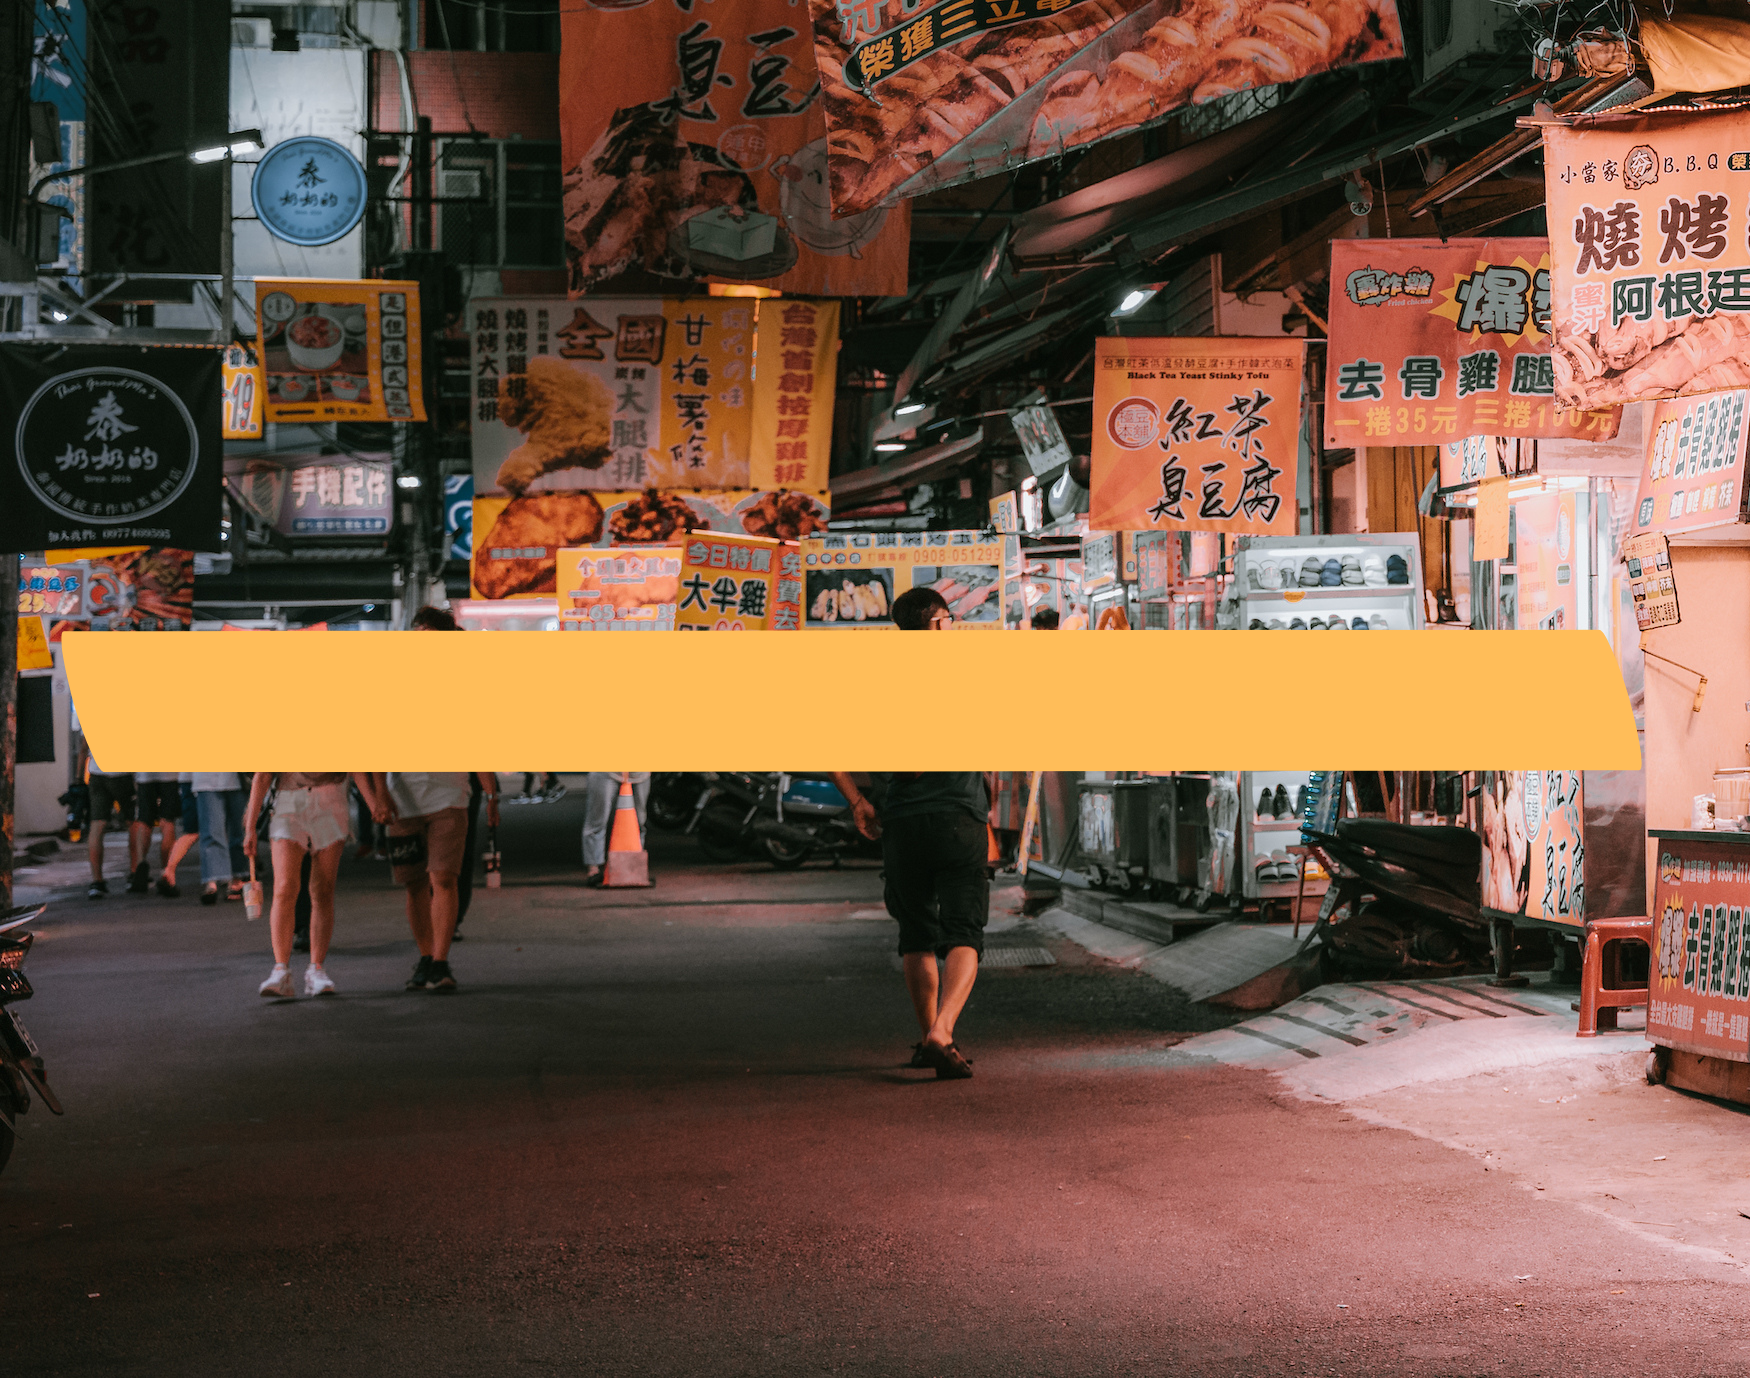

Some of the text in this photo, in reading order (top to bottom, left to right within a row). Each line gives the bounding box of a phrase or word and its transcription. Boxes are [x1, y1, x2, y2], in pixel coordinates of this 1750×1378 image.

[1560, 159, 1619, 184] 小當家
[1456, 265, 1551, 334] 爆
[1572, 283, 1606, 335] 蜜汁
[556, 307, 667, 365] 全國
[1209, 372, 1243, 381] Stinky
[84, 390, 139, 441] 泰
[612, 384, 649, 484] 大腿排
[1159, 389, 1273, 459] 紅茶
[1334, 406, 1458, 437] 一捲35元
[1673, 389, 1747, 480] 去骨雞腿捲
[55, 443, 158, 470] 奶奶的
[291, 466, 386, 507] 手機配件
[1147, 454, 1282, 522] 臭豆腐
[688, 543, 772, 571] 今日特價
[589, 604, 615, 620] 65
